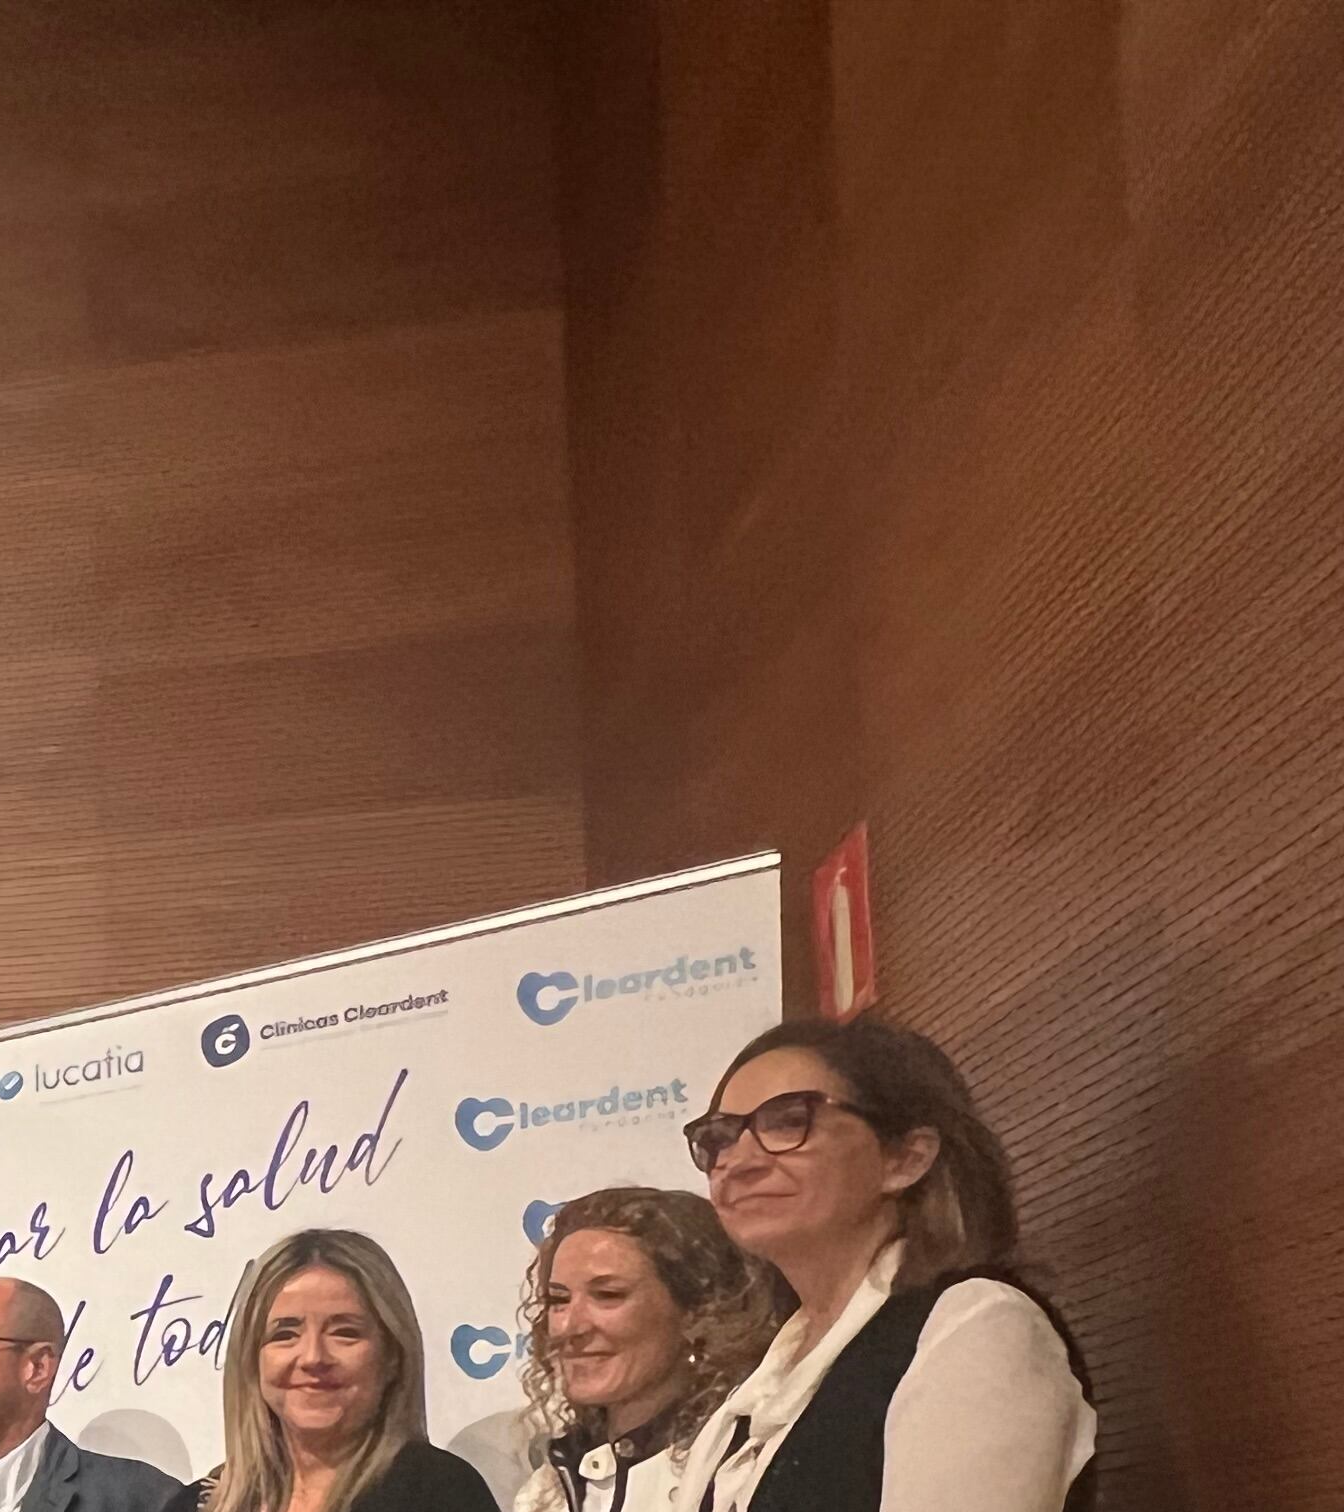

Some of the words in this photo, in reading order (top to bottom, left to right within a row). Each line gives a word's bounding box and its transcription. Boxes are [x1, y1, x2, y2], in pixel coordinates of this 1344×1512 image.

[343, 988, 449, 1023] Cleardent
[515, 946, 758, 1027] Cleardent
[34, 1045, 144, 1093] lucatia
[454, 1077, 690, 1152] Cleardent
[93, 1149, 171, 1255] la
[183, 1067, 410, 1239] salud
